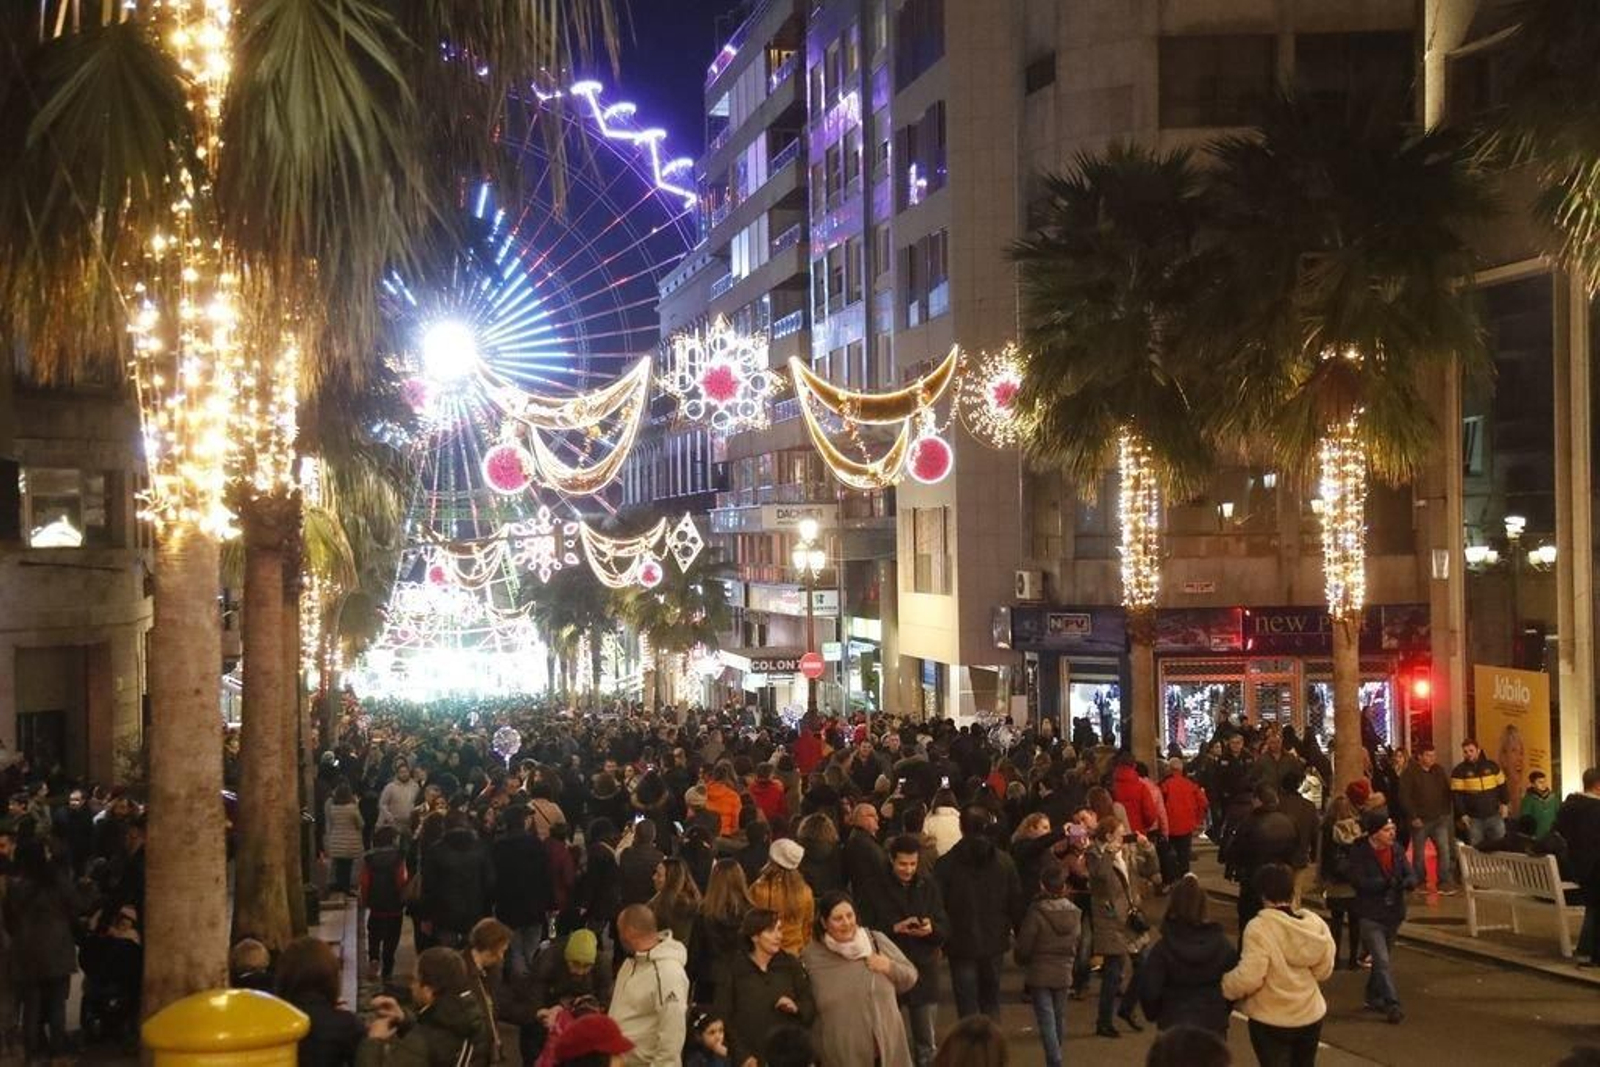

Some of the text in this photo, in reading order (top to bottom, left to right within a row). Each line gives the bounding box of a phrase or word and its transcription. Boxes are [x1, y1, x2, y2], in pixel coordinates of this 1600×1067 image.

[1051, 617, 1085, 630] NPV
[1255, 614, 1307, 633] new
[1493, 674, 1530, 703] Júbilo
